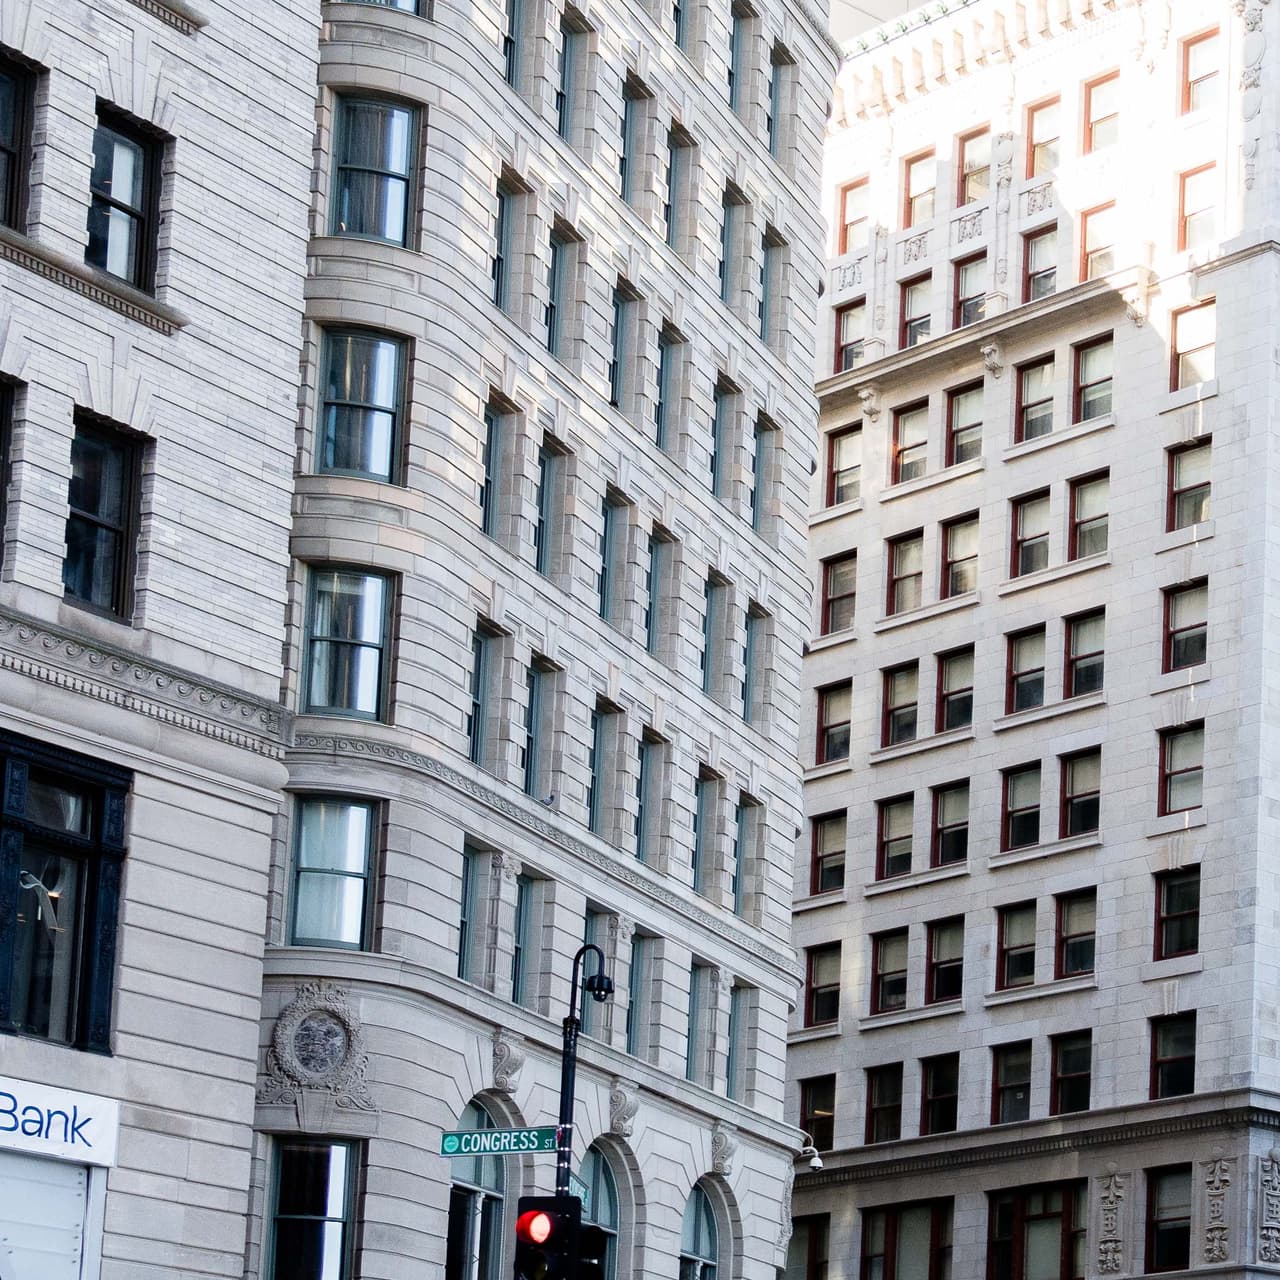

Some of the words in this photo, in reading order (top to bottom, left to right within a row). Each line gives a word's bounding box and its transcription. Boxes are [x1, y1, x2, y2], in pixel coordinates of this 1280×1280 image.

[0, 1091, 93, 1147] Bank
[461, 1131, 538, 1152] CONGRESS
[544, 1138, 553, 1149] ST
